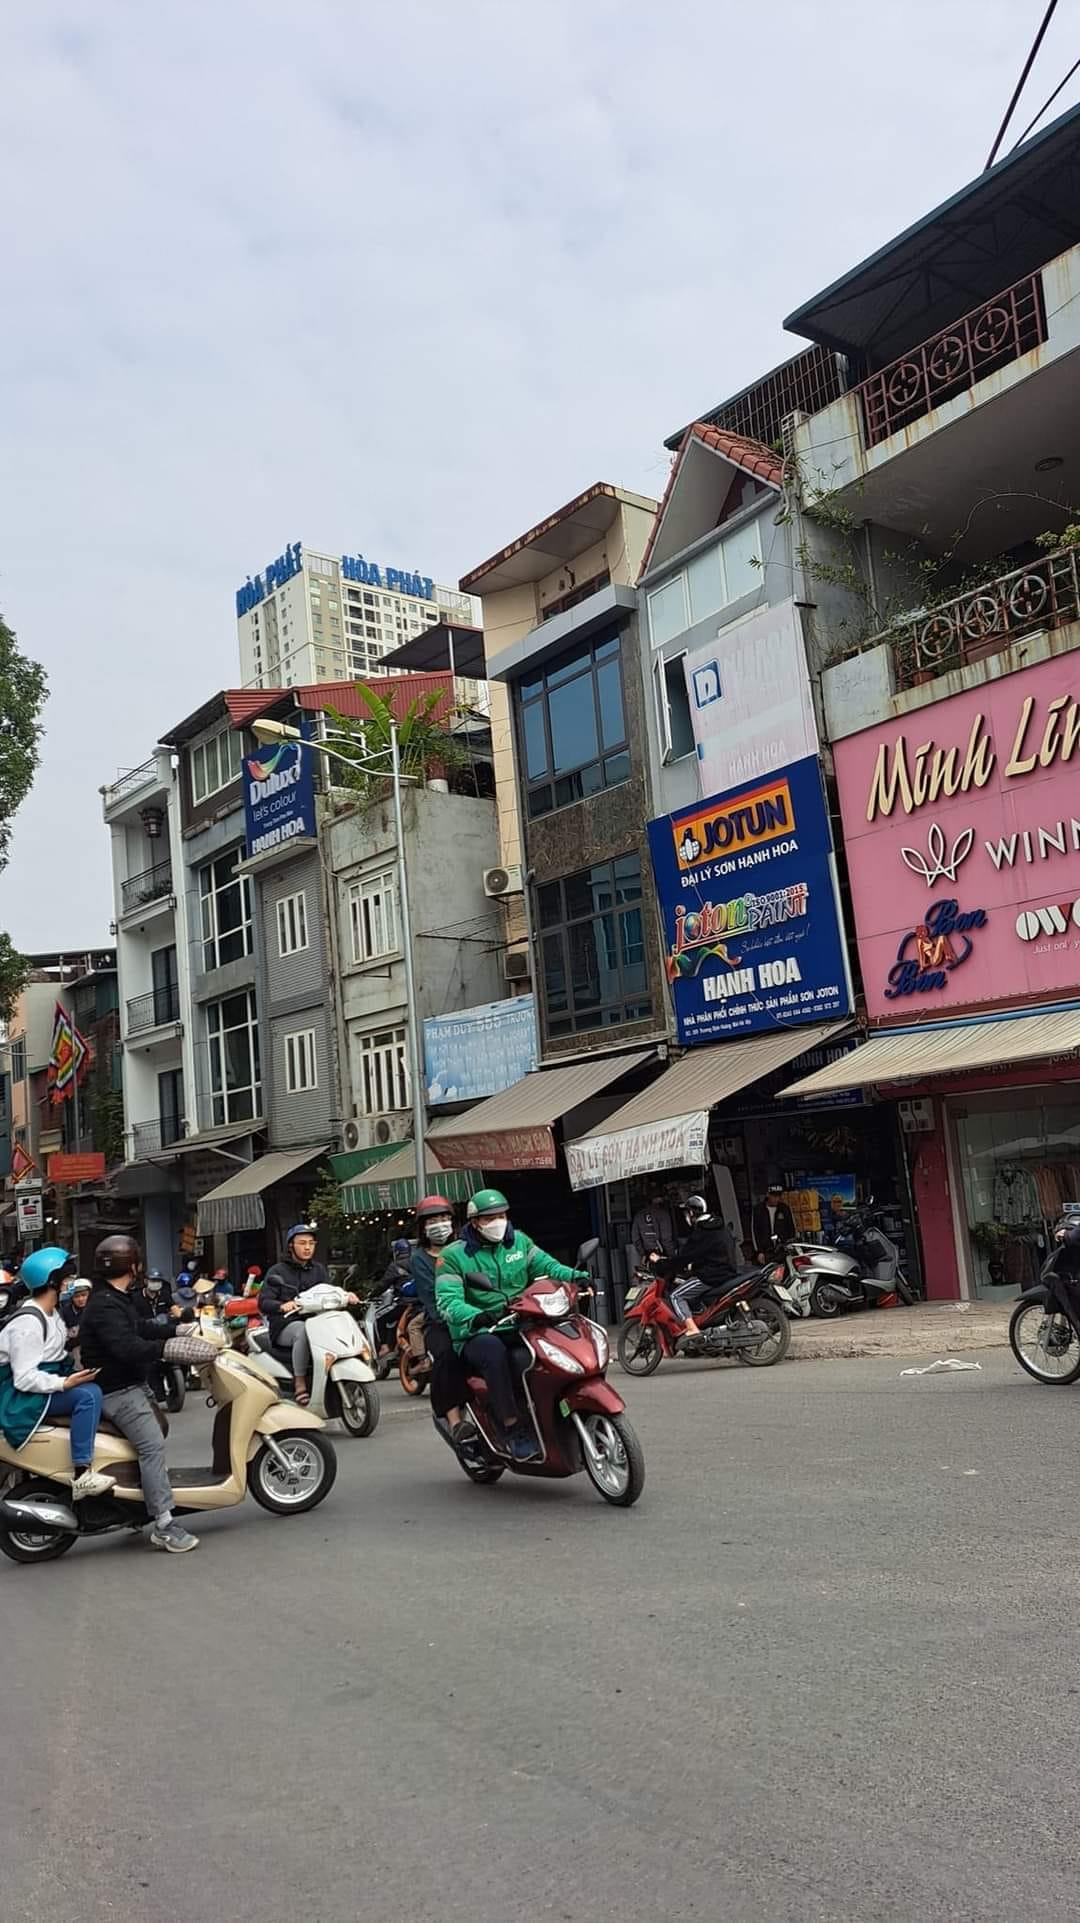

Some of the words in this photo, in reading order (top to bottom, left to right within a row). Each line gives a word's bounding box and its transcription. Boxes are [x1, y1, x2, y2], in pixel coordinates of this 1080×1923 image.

[342, 554, 382, 587] HÒA
[386, 570, 432, 600] PHÁT
[250, 765, 300, 806] Dulux
[270, 791, 296, 813] colour
[281, 817, 305, 841] HOA
[703, 794, 788, 854] JOTUN
[681, 873, 699, 888] ĐẠI
[714, 860, 737, 877] SƠN
[738, 850, 770, 869] HẠNH
[772, 839, 799, 858] HOA
[672, 898, 748, 956] joton
[747, 892, 808, 930] PAINT
[703, 967, 756, 1003] HẠNH
[758, 957, 802, 989] HOA
[816, 985, 839, 998] JOTON
[505, 1250, 524, 1264] Grab
